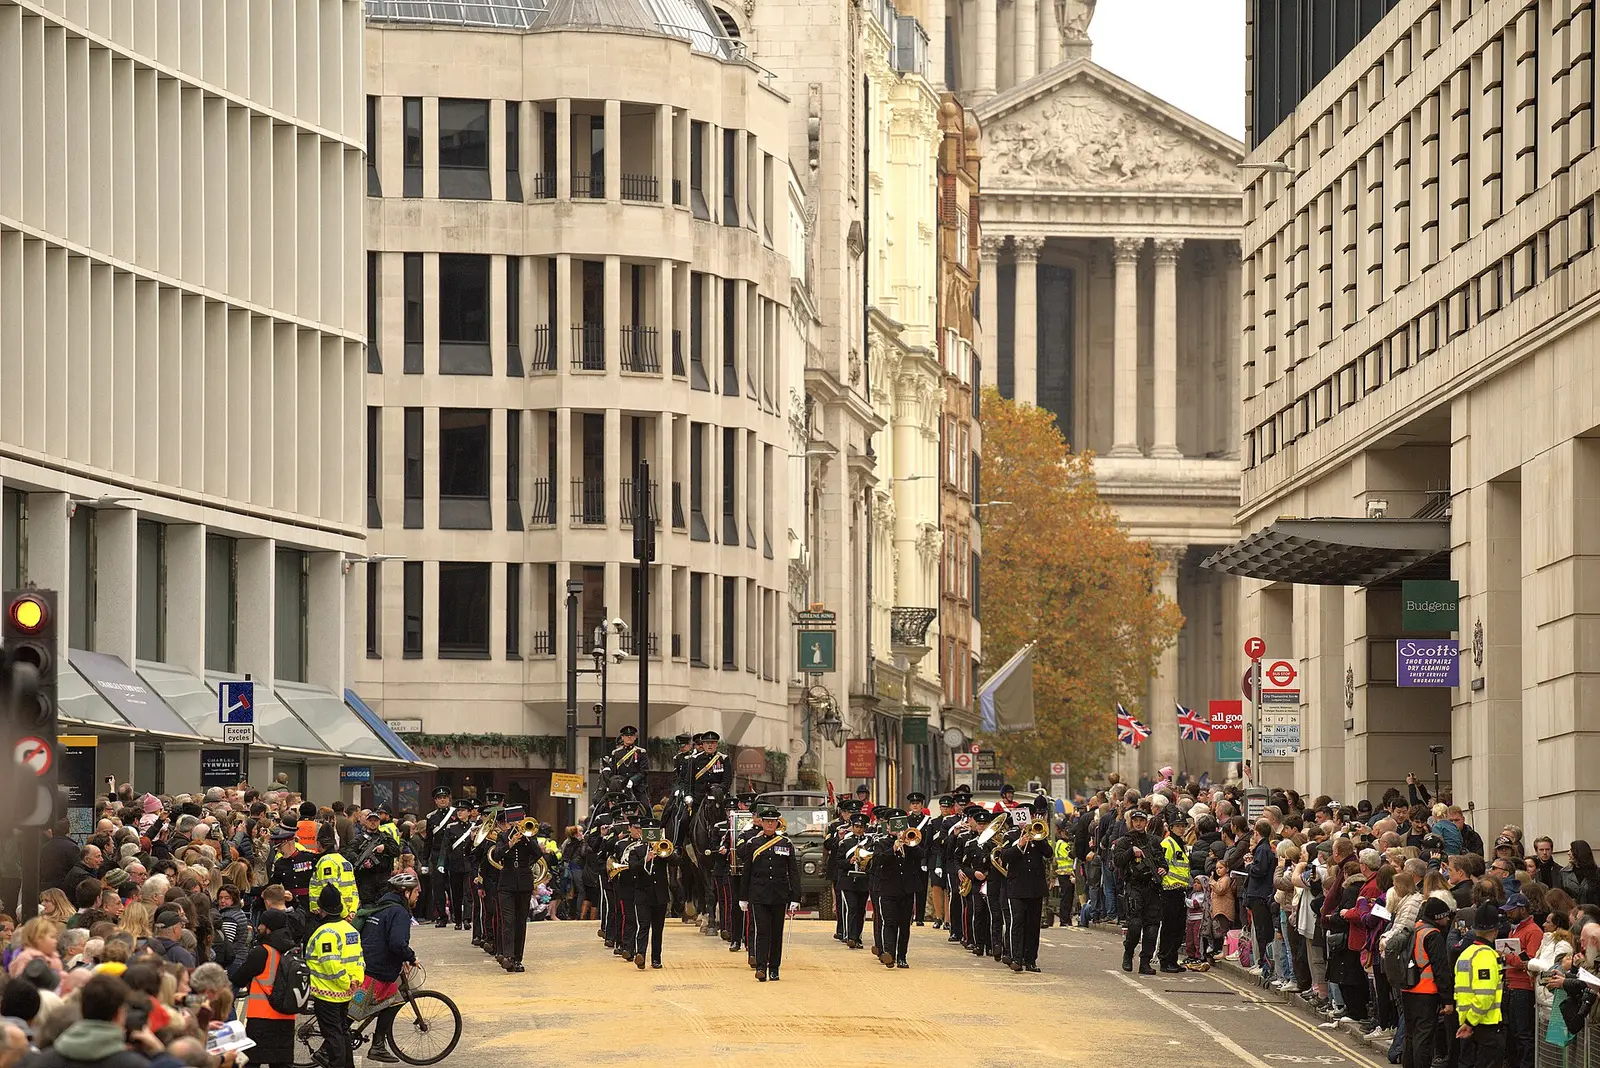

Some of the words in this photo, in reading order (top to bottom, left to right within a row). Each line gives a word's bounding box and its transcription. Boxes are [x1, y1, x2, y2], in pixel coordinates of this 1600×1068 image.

[1406, 600, 1456, 613] Budgens
[1251, 640, 1261, 652] F
[1400, 642, 1458, 657] Scotts
[1211, 712, 1225, 722] all
[227, 727, 251, 735] Except
[228, 734, 250, 742] cycles
[458, 744, 520, 759] KITCHEN
[972, 745, 979, 753] G
[1015, 811, 1027, 821] 33
